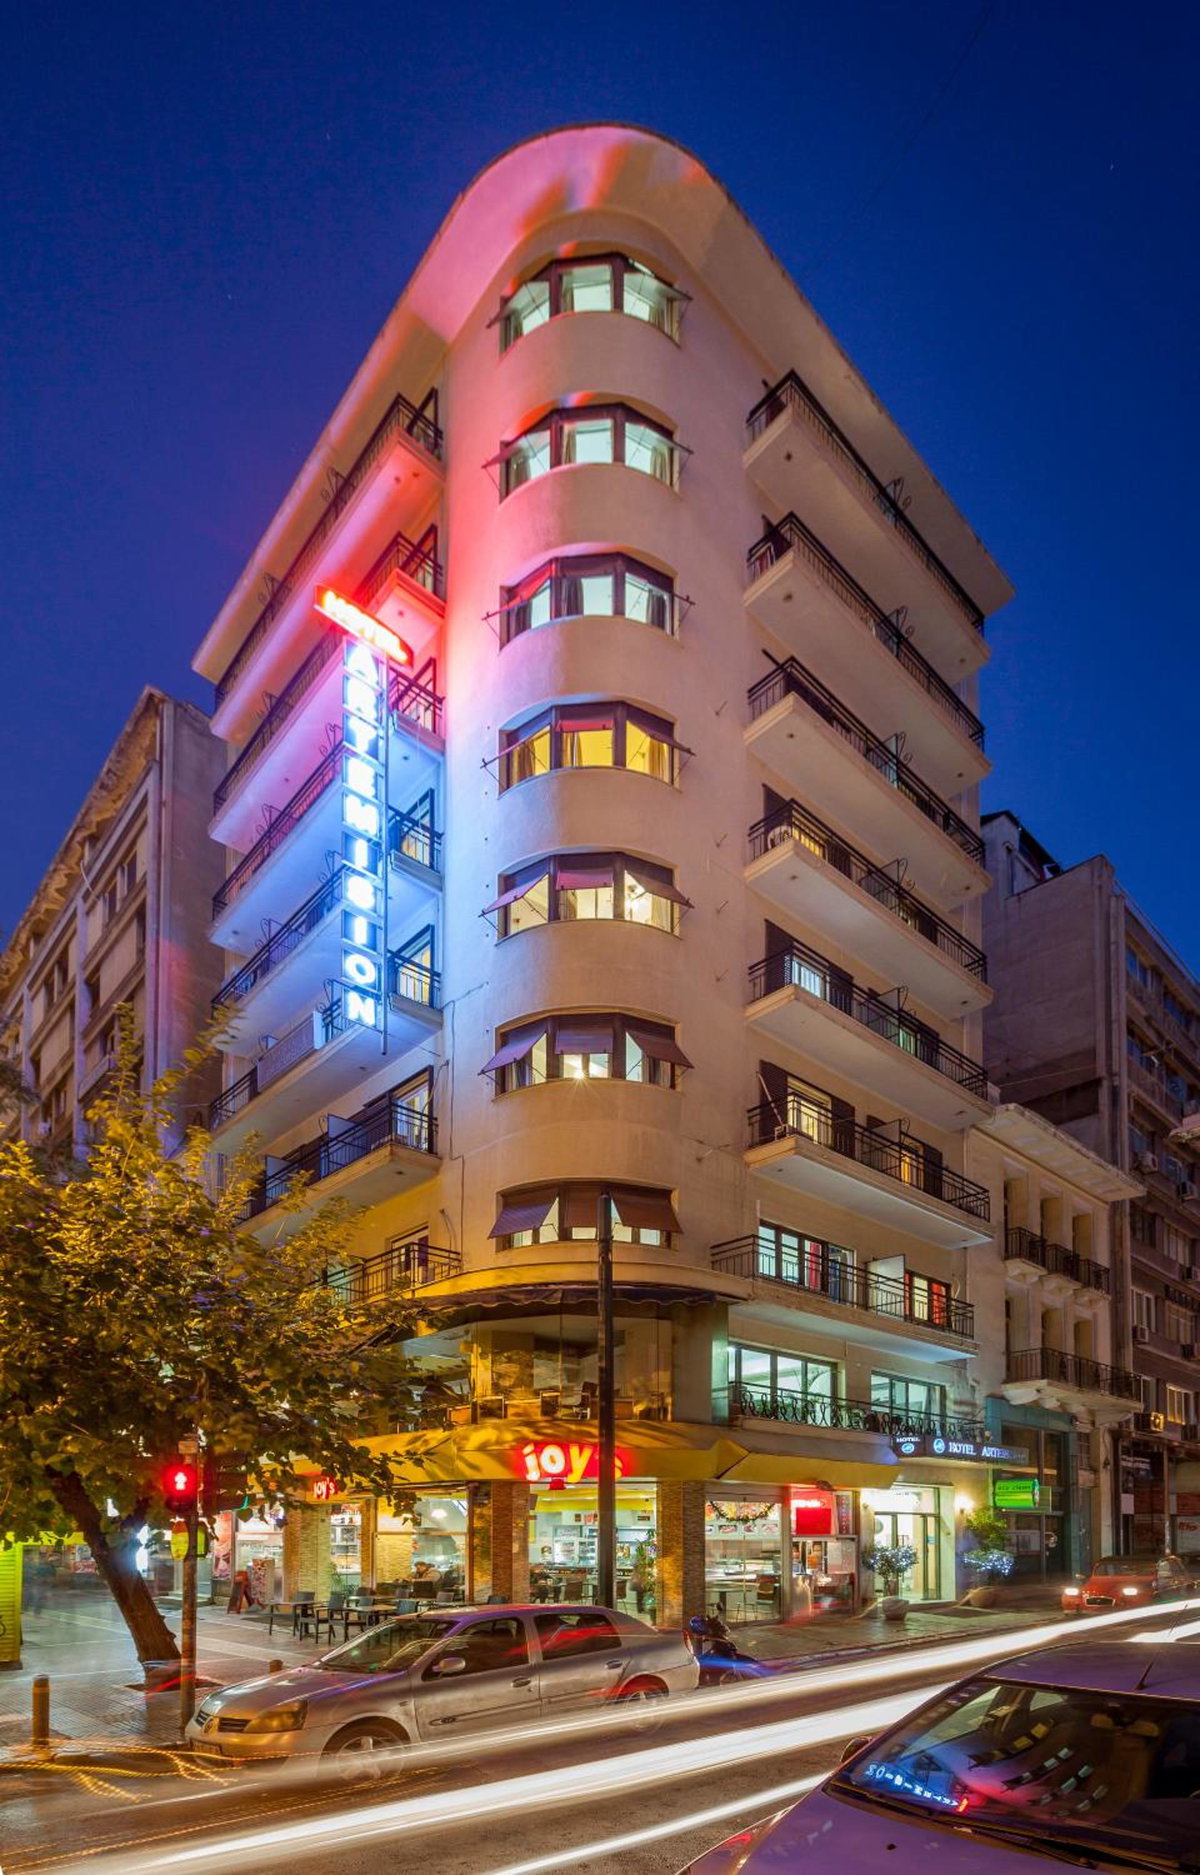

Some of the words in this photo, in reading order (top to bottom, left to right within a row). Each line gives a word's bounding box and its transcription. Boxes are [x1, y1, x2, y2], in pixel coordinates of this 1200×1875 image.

[344, 643, 381, 1026] ARTEMISION
[522, 1442, 622, 1484] joy
[948, 1441, 977, 1456] HOTEL
